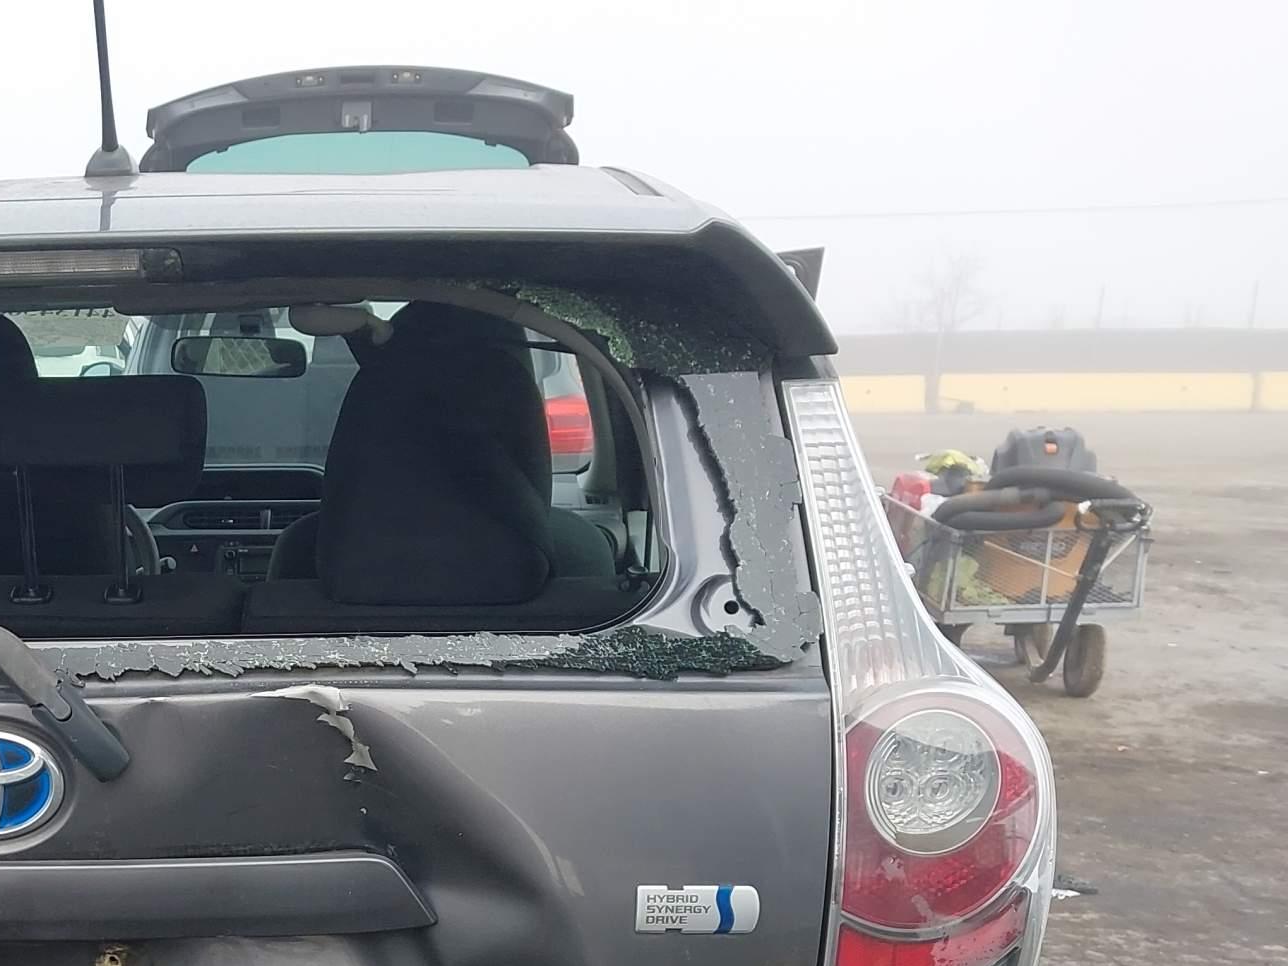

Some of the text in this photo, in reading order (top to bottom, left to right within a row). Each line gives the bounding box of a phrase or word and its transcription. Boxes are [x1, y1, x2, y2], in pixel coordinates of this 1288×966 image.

[646, 894, 699, 904] HYBRID
[646, 905, 712, 914] SYNERGY
[645, 915, 688, 925] DRIVE
